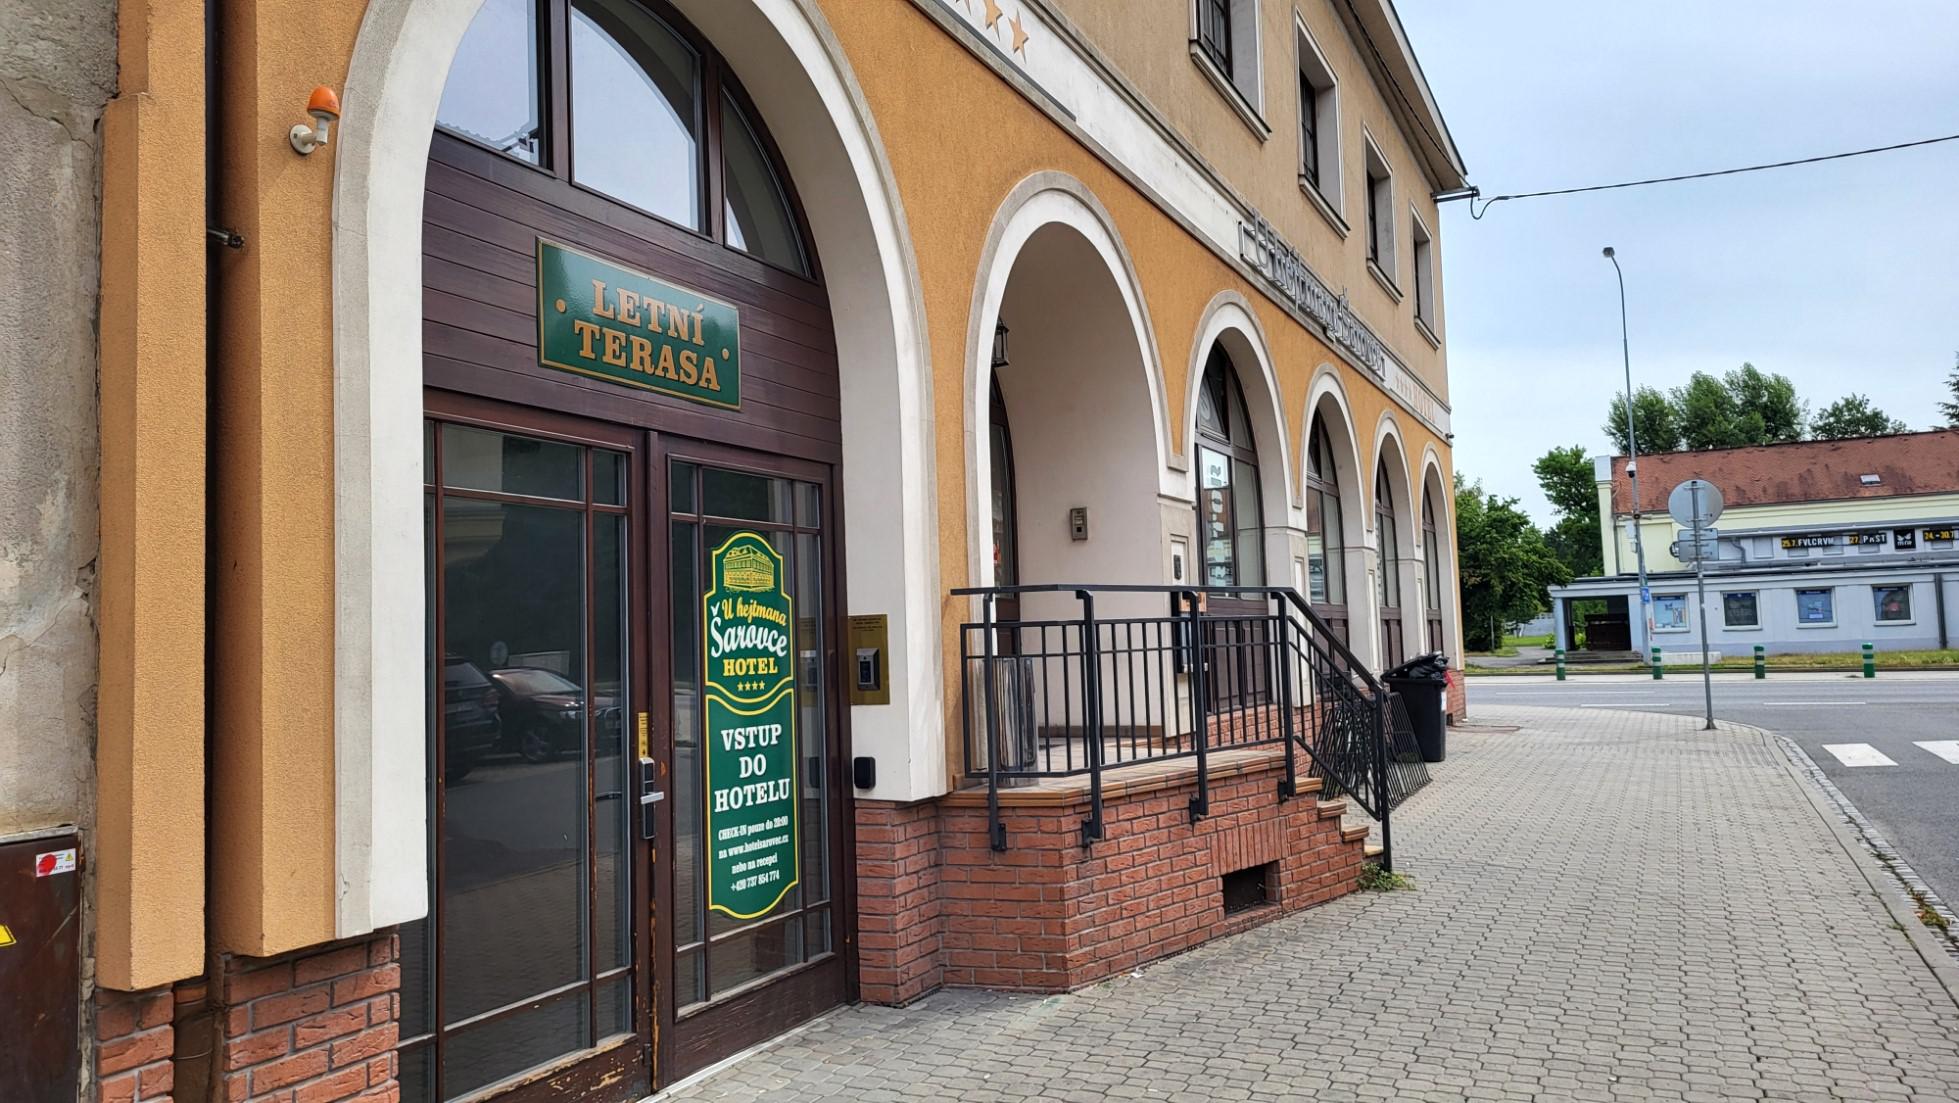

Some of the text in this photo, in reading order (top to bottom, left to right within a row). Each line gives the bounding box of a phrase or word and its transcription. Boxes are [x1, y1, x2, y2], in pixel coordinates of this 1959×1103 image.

[592, 279, 705, 346] LETNÍ
[574, 319, 721, 391] TERASA
[722, 596, 787, 626] U hejtmana
[710, 601, 787, 658] Šarovce
[722, 657, 778, 677] HOTEL
[721, 724, 782, 751] VSTUP
[739, 753, 767, 779] DO
[714, 778, 790, 813] HOTELU
[718, 824, 747, 841] CHECK-IN
[765, 819, 773, 829] do
